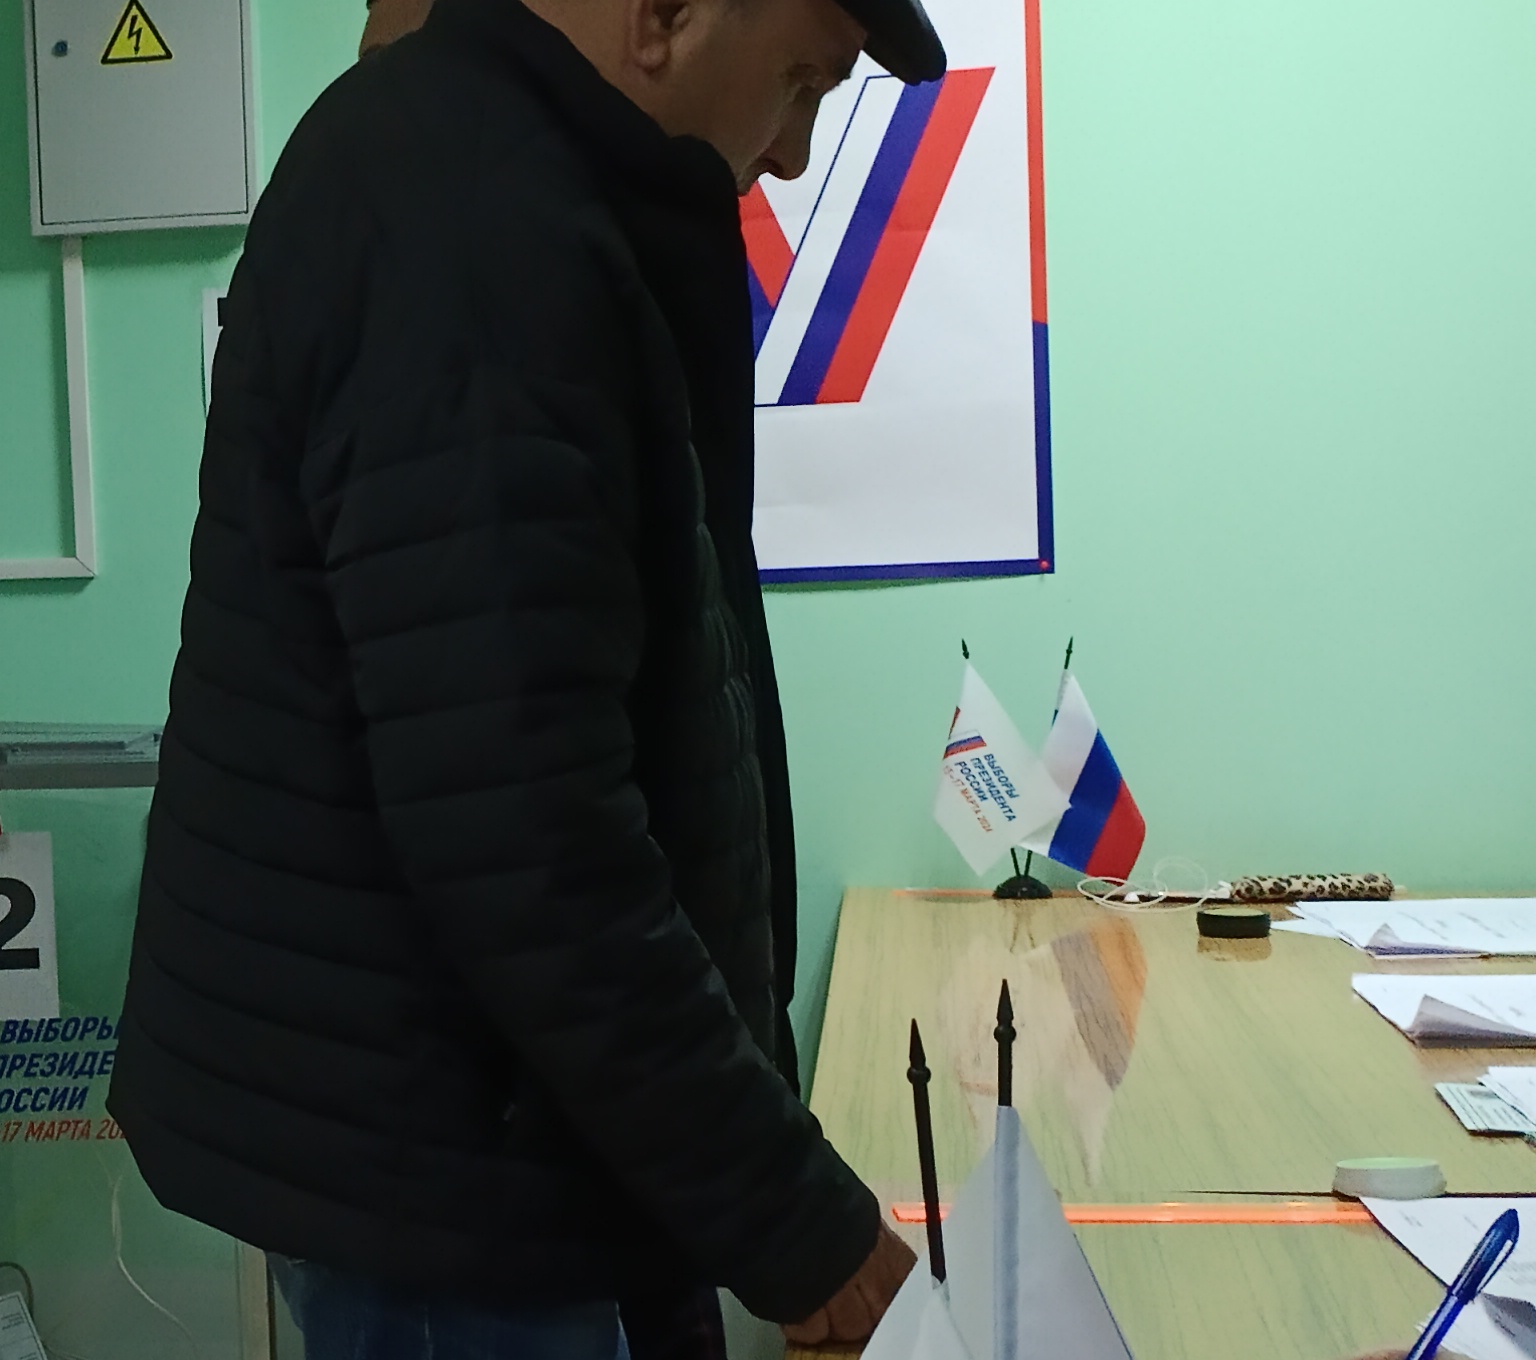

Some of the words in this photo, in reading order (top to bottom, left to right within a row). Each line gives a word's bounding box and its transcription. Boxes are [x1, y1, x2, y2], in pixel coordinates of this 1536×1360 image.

[954, 761, 988, 802] РОССИИ
[970, 757, 1016, 822] ПРЕЗИДЕНТА
[983, 753, 1020, 799] ВЫБОРЫ
[25, 1119, 92, 1142] МАРТА
[95, 1118, 126, 1140] 20
